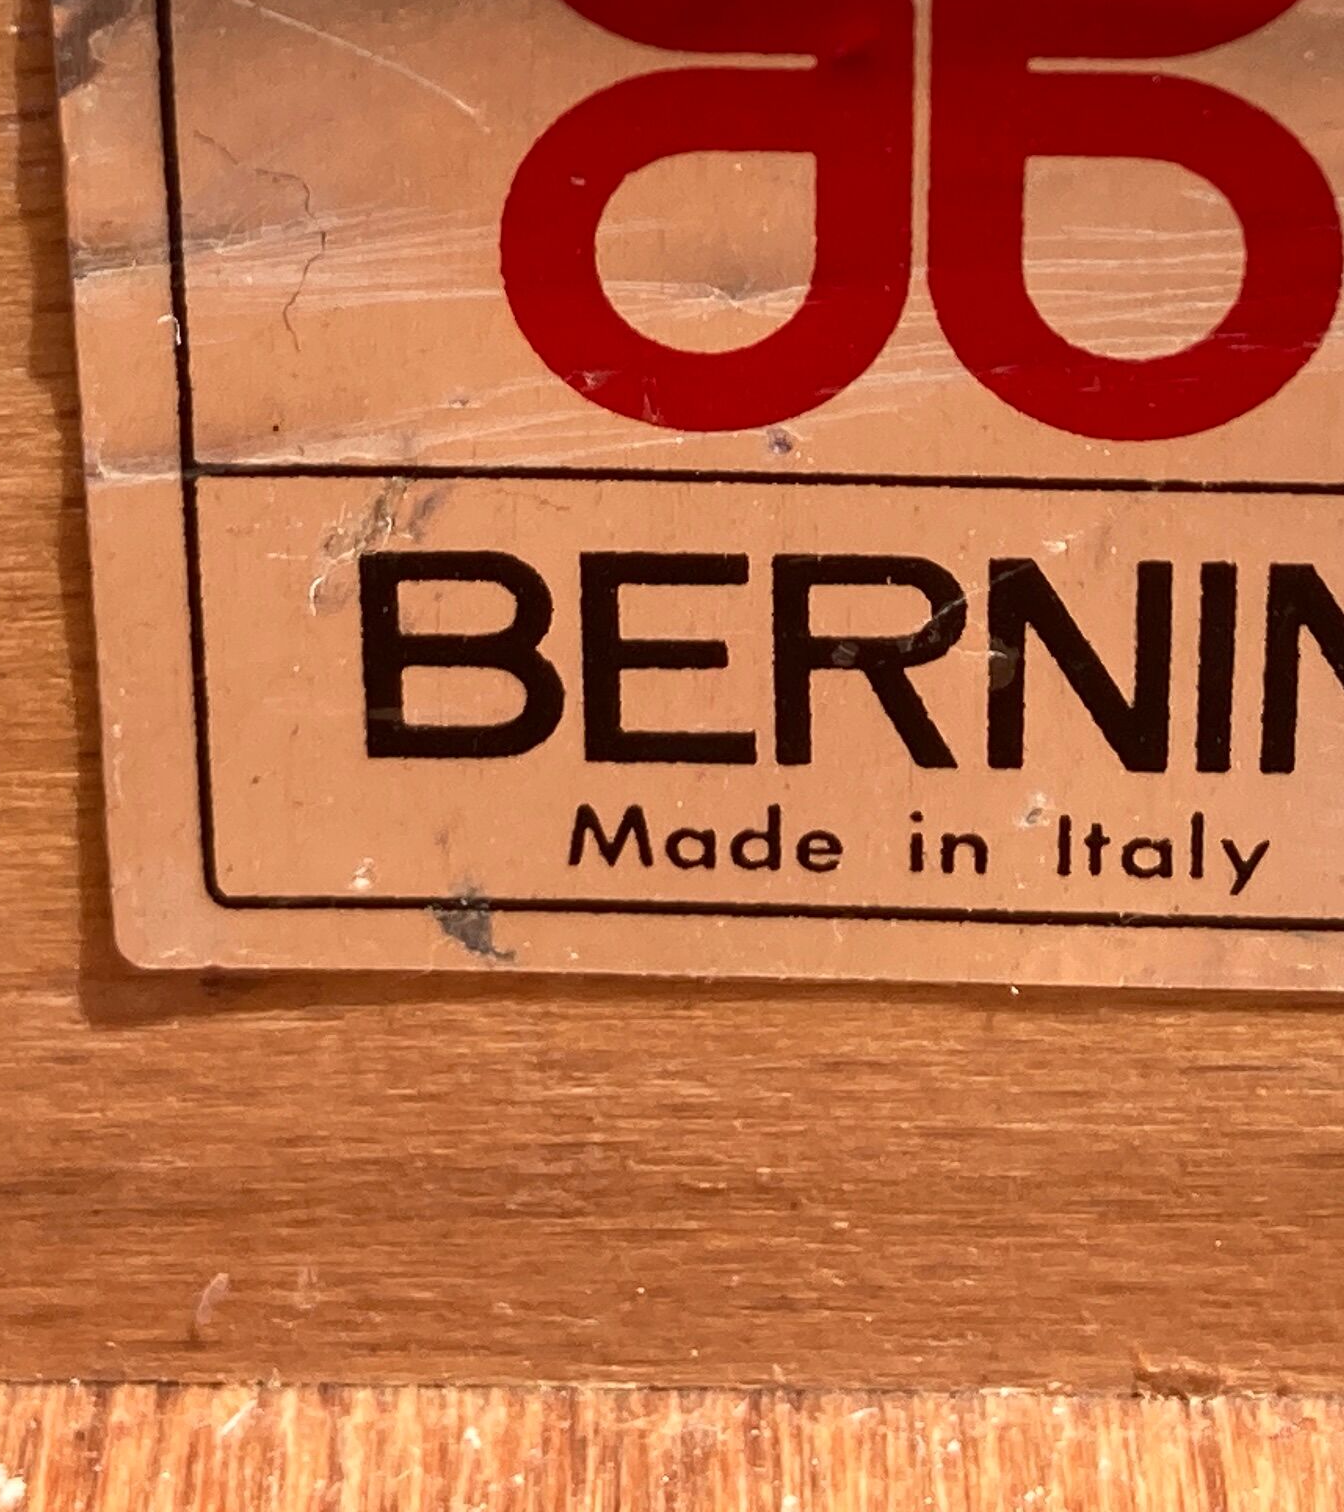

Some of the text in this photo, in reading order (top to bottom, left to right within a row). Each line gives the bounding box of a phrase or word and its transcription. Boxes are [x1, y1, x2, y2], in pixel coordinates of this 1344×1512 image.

[566, 802, 1271, 897] Made in Italy
